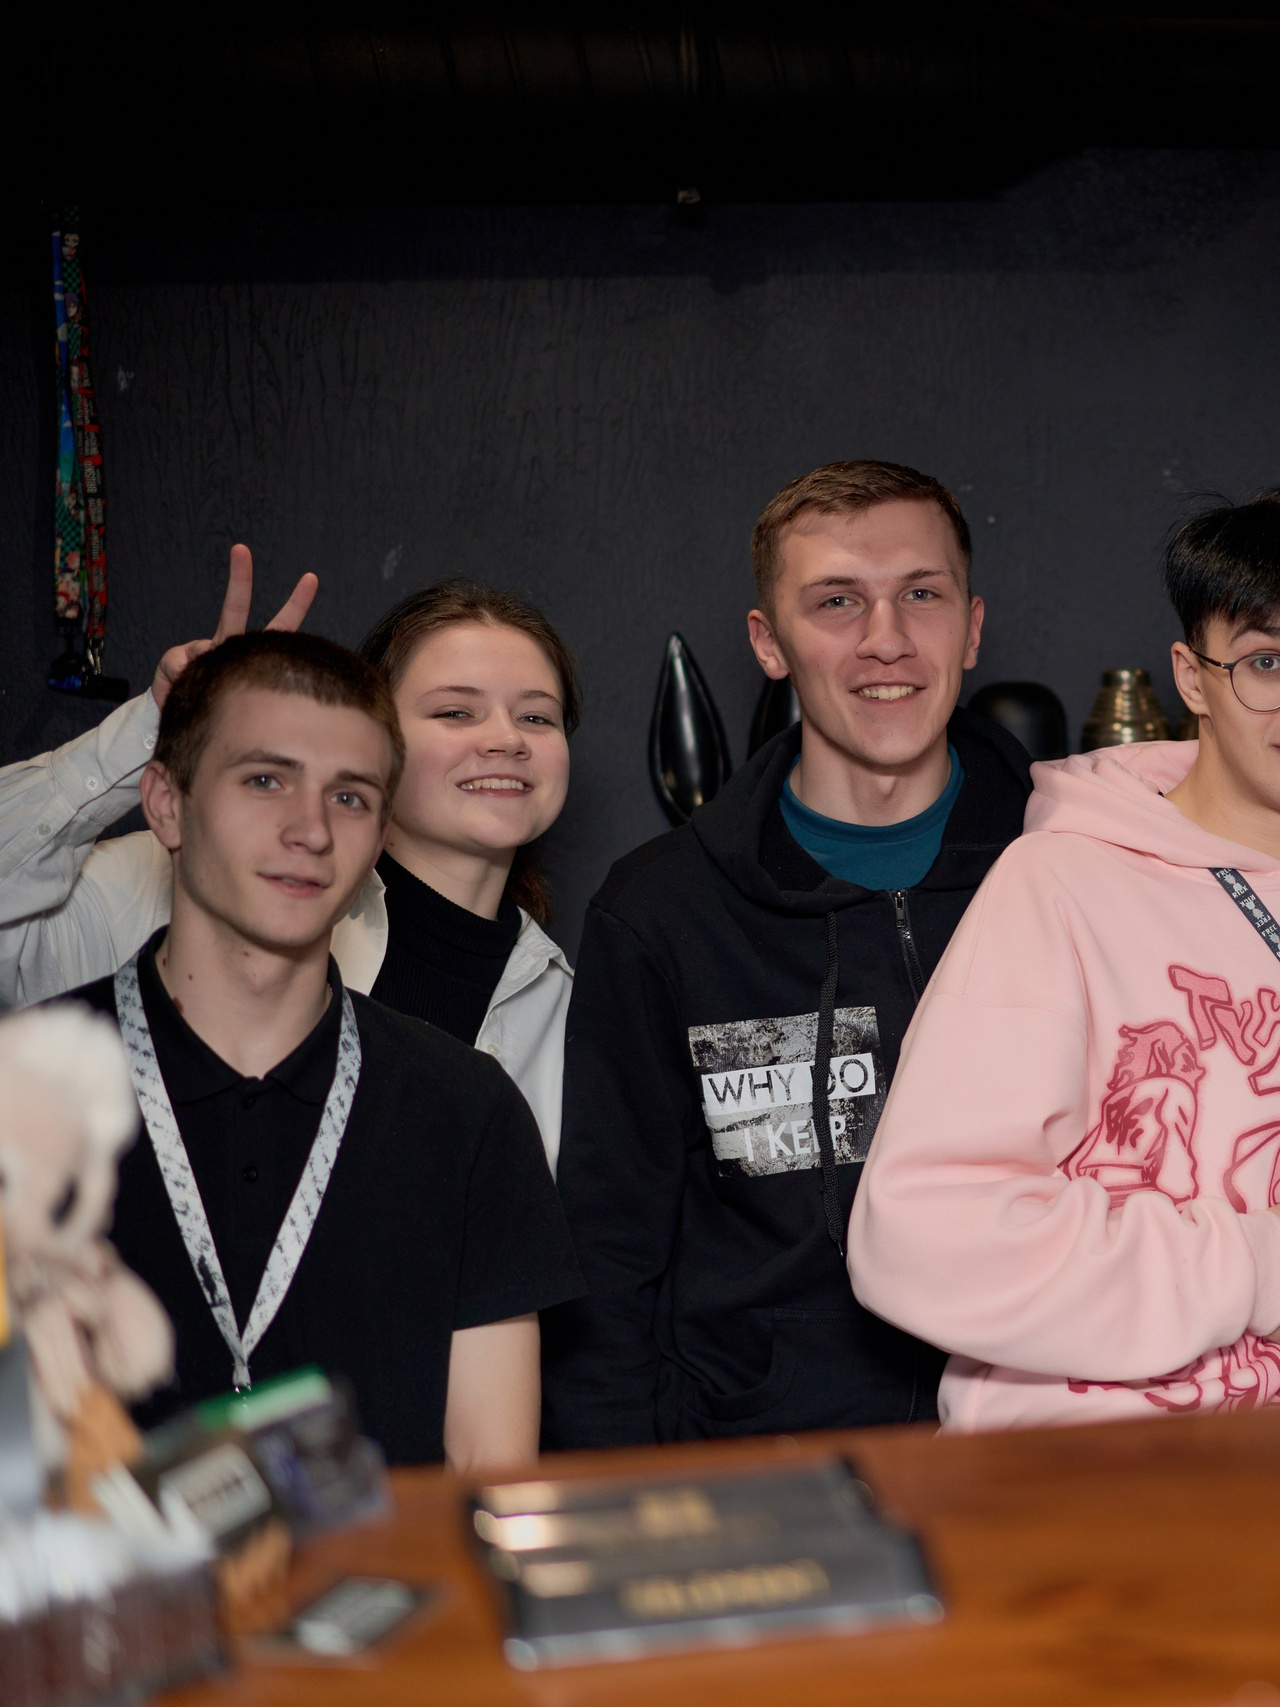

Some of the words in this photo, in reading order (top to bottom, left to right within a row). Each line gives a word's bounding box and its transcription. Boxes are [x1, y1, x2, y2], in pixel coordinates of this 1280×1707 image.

[1231, 885, 1249, 899] RICK
[1255, 914, 1272, 928] FREE
[1261, 924, 1278, 937] FREE
[707, 1066, 796, 1110] WHY
[766, 1115, 847, 1159] KEP
